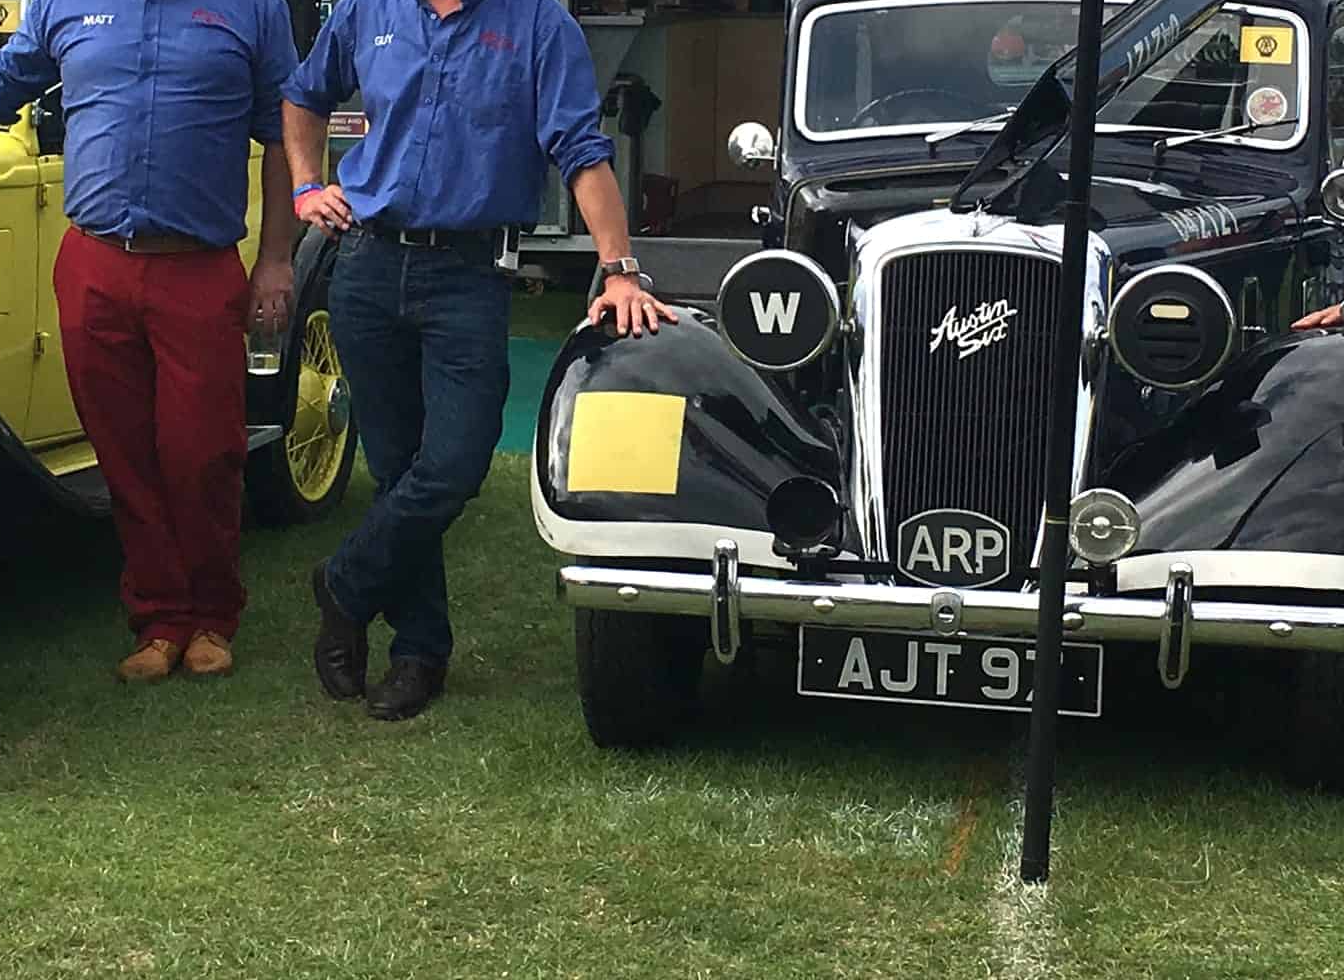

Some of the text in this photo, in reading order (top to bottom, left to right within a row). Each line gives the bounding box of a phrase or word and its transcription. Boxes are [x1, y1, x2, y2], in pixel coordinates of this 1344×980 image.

[83, 14, 115, 27] MATT
[374, 33, 394, 46] GUY
[748, 291, 801, 334] W
[929, 299, 1018, 354] Austin
[958, 317, 1009, 360] Six
[905, 524, 1005, 575] ARP
[837, 636, 962, 697] AJT
